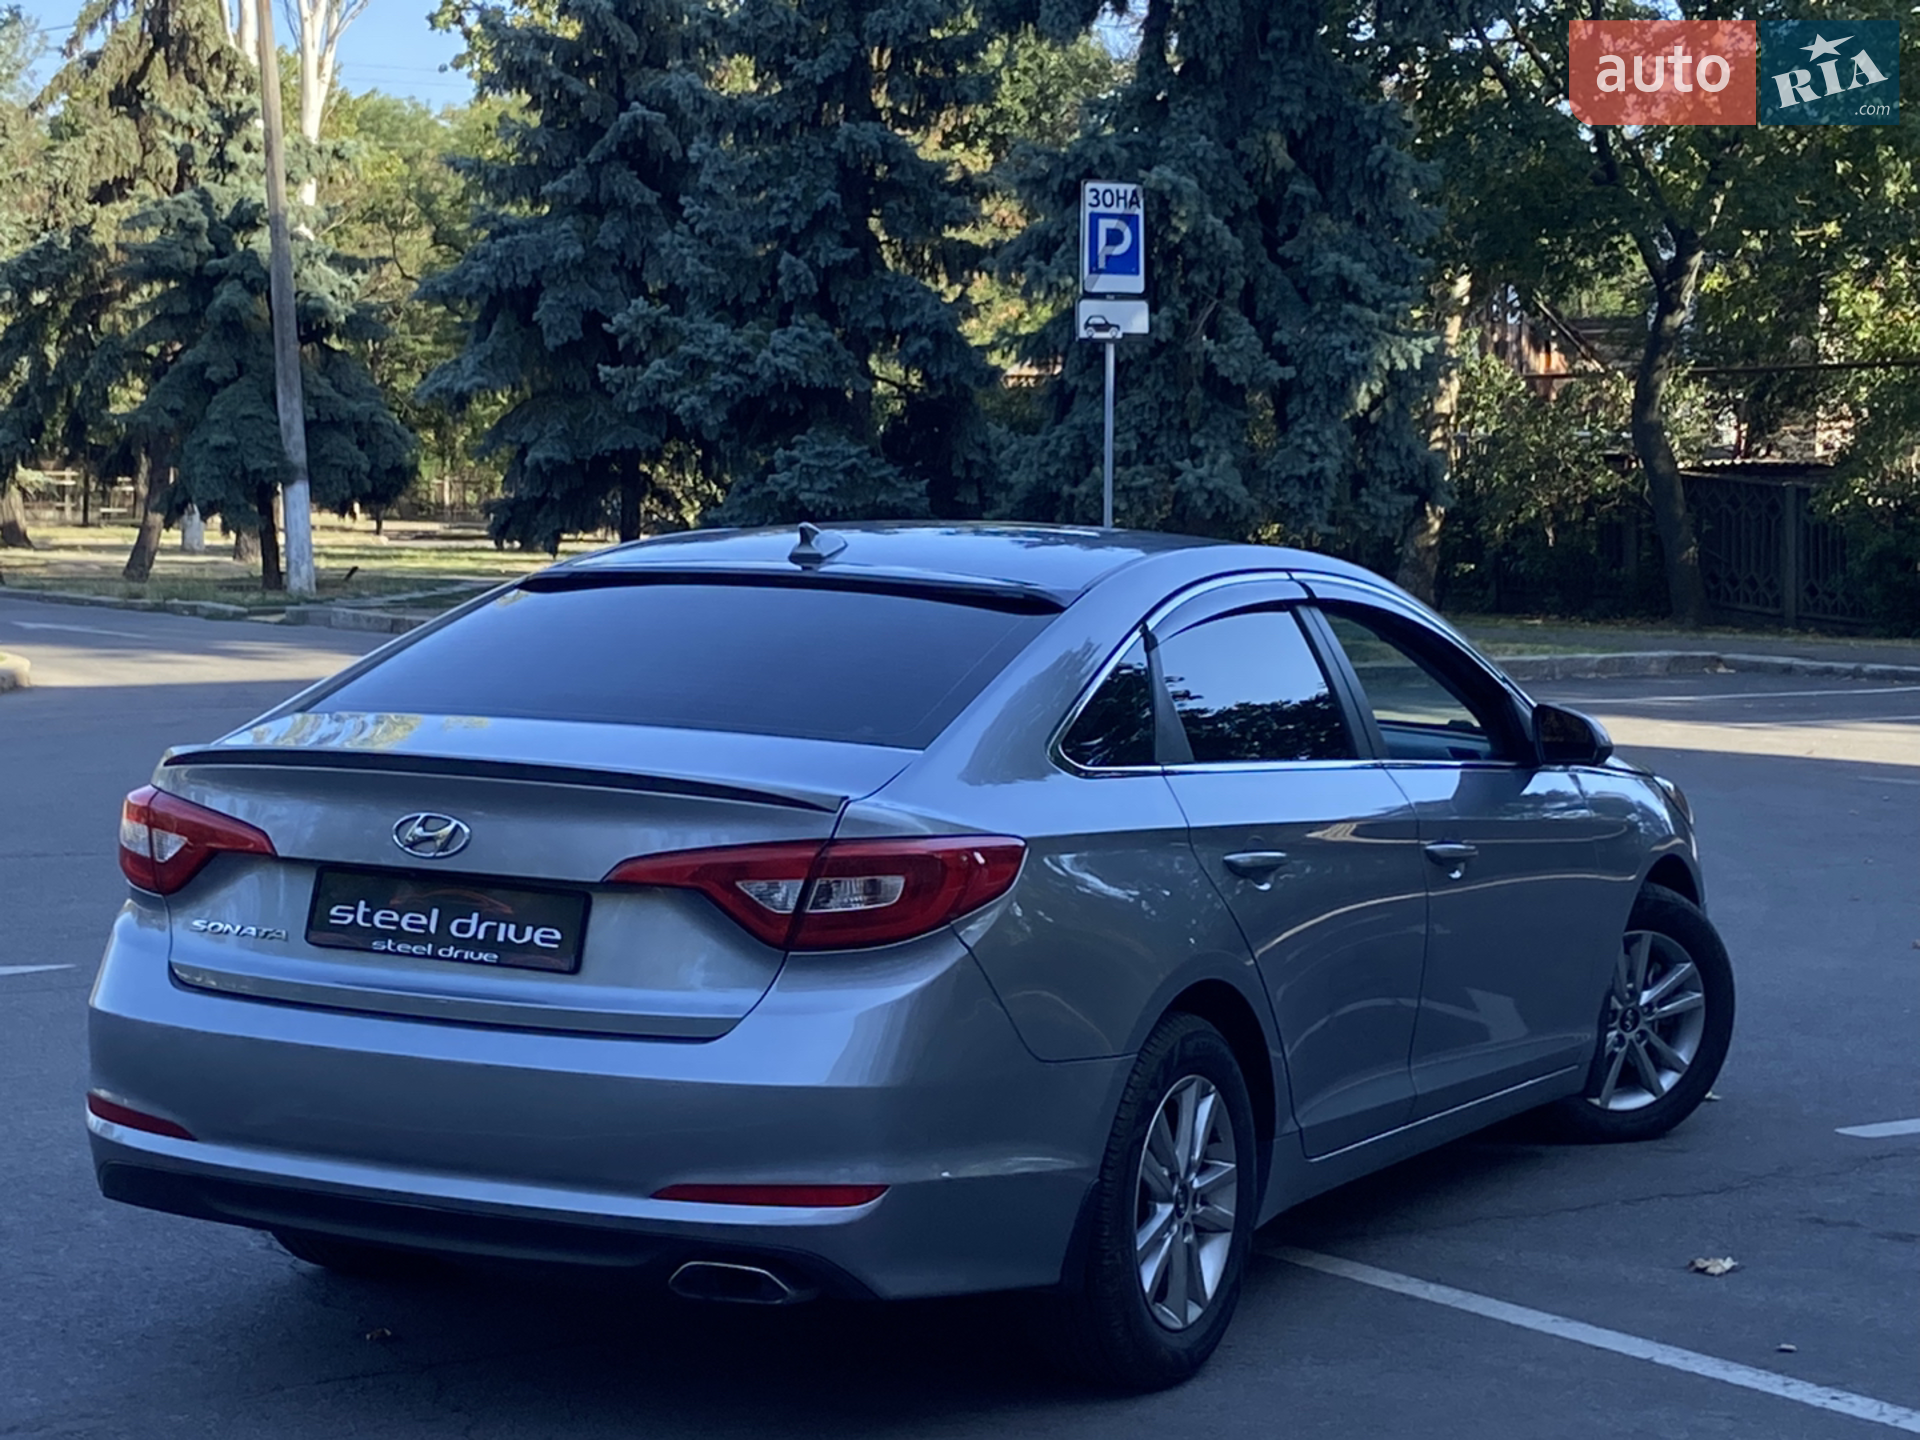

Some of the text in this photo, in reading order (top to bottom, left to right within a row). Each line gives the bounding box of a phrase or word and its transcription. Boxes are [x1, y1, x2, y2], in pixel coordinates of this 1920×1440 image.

[1088, 188, 1141, 209] ЗОНА
[190, 919, 287, 941] SONATA
[329, 900, 562, 948] steel drive
[372, 938, 499, 963] steel drive
